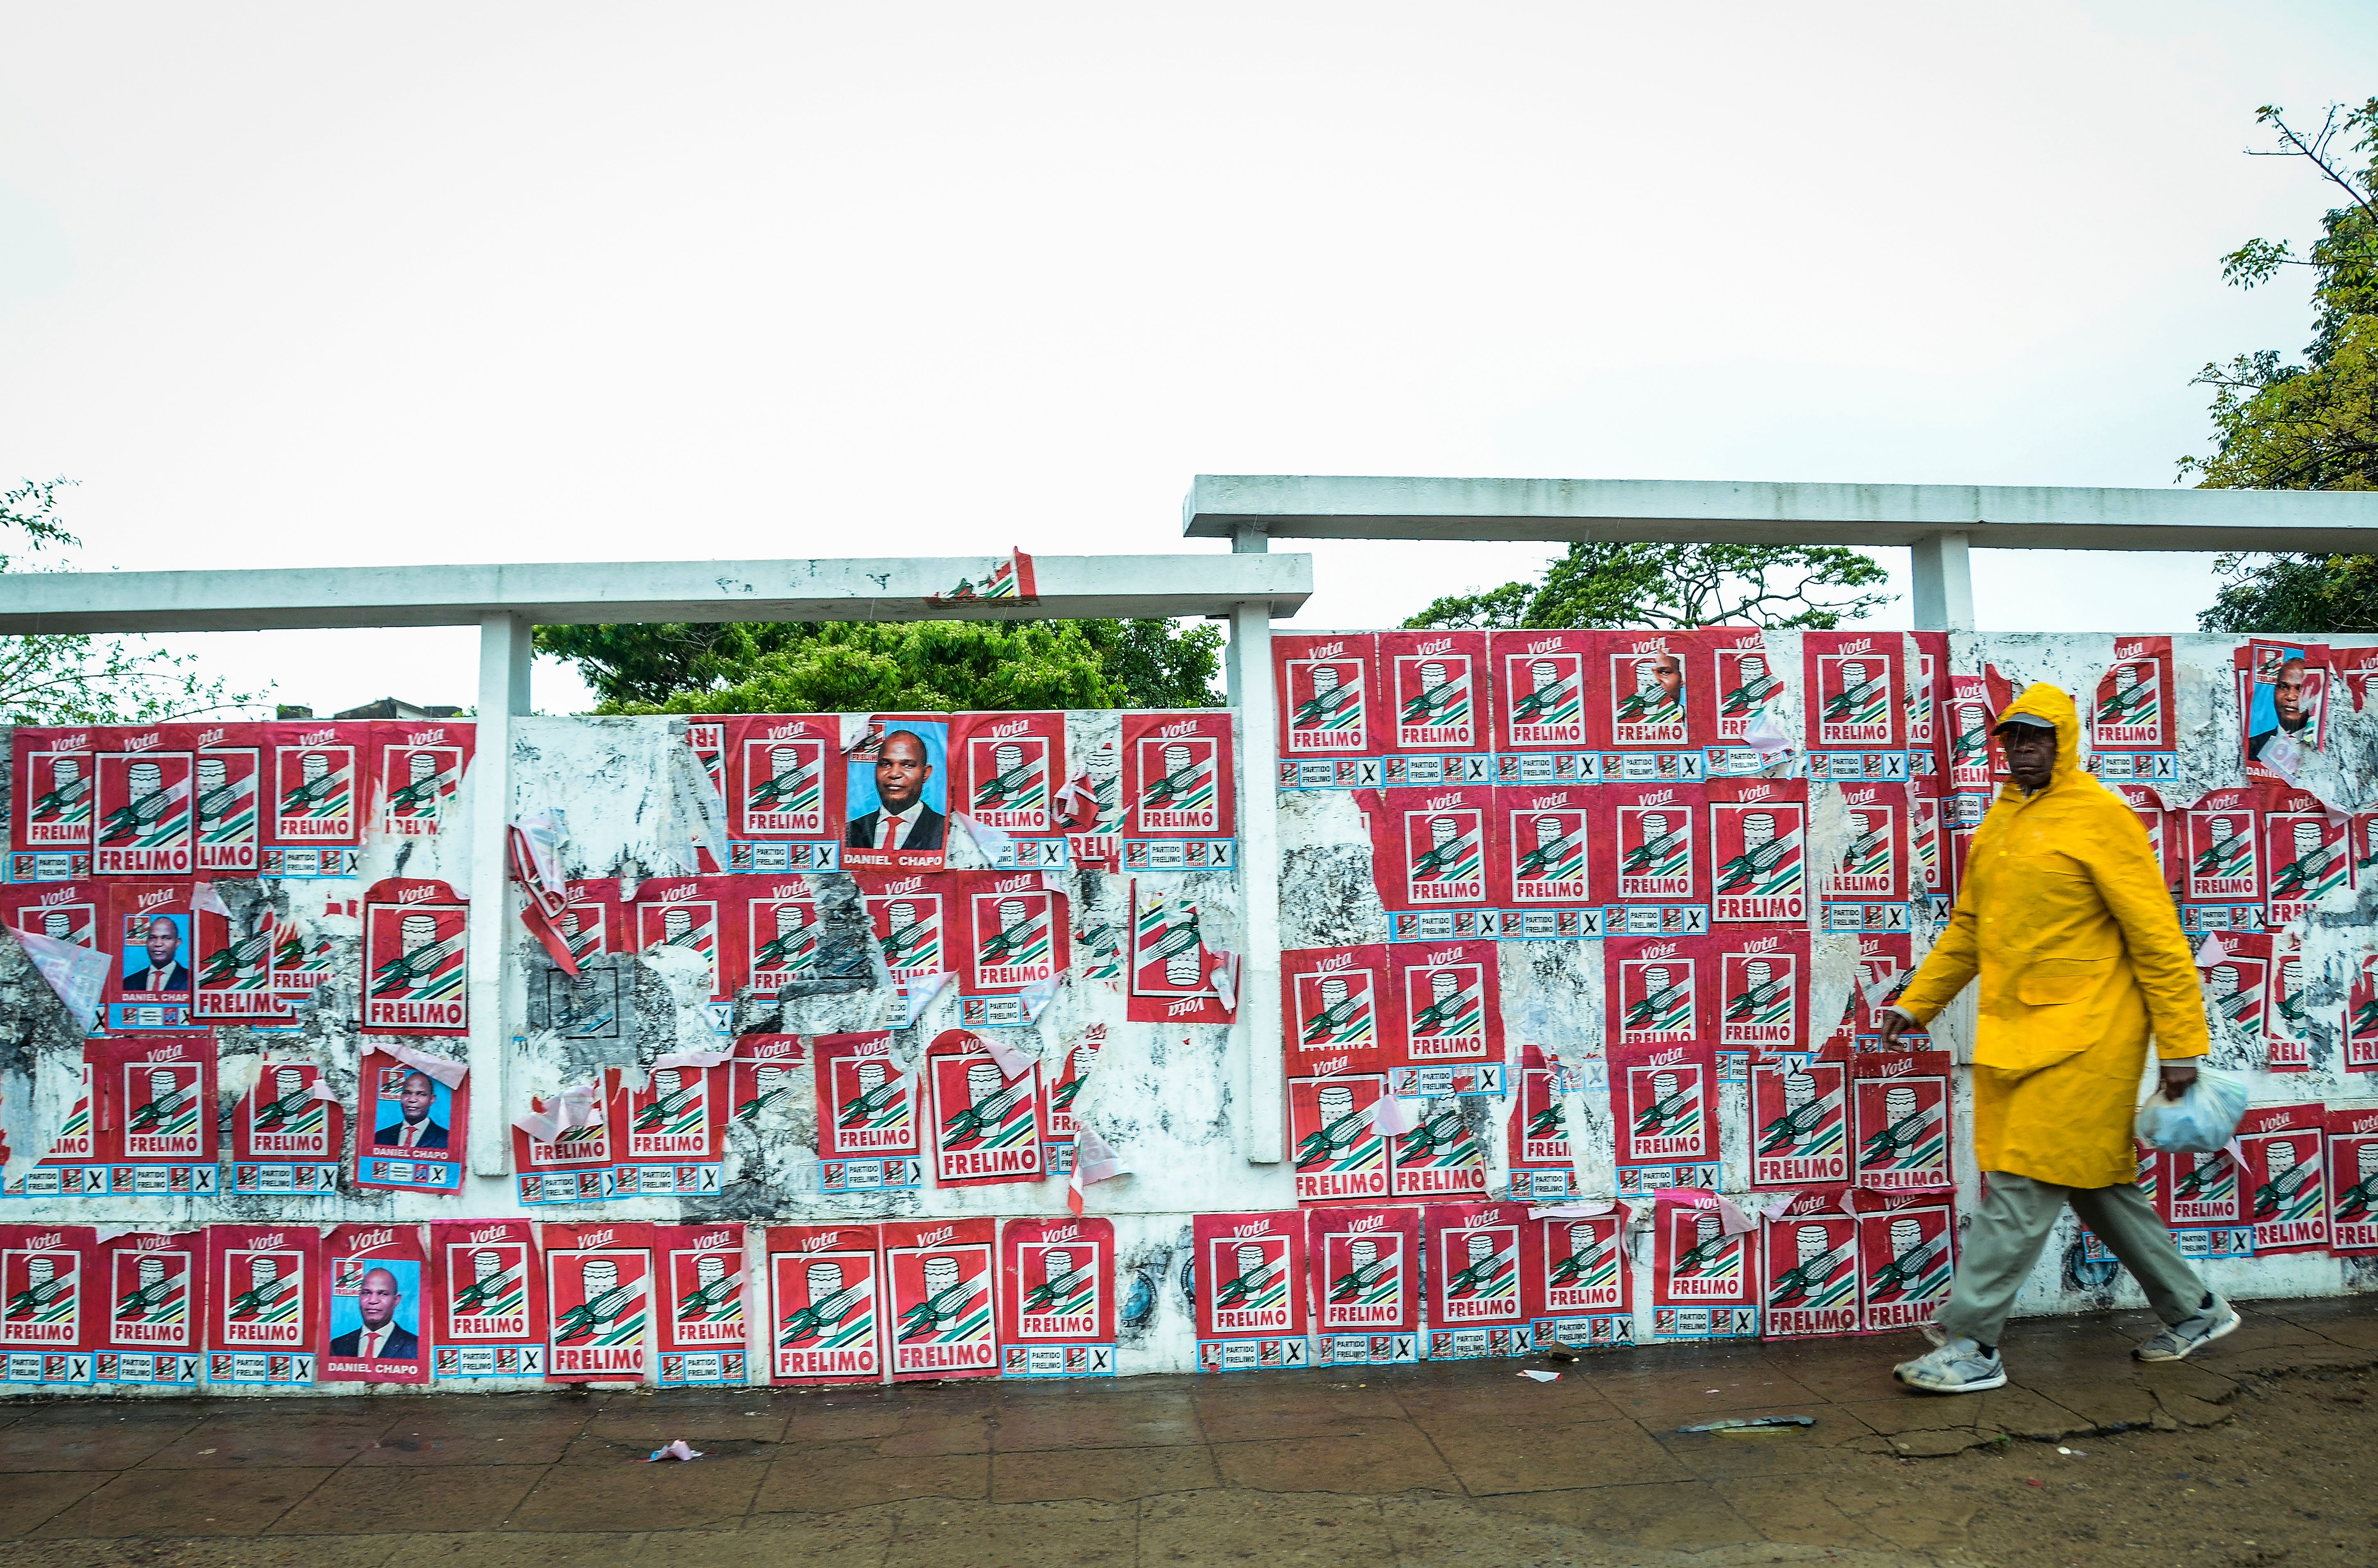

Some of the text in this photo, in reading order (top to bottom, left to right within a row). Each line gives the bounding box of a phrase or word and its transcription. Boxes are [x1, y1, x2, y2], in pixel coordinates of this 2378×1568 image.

[1308, 639, 1344, 659] Vota
[1416, 637, 1452, 655] Vota
[1527, 636, 1563, 654] Vota
[1633, 636, 1665, 654] Vota
[1838, 636, 1871, 654] Vota
[299, 728, 336, 747] Vota
[408, 728, 445, 746] Vota
[768, 721, 803, 739] Vota
[991, 720, 1028, 737] Vota
[1161, 719, 1197, 738] Vota
[1403, 728, 1468, 742] FRELIMO
[1515, 726, 1580, 740] FRELIMO
[1619, 726, 1682, 739] FRELIMO
[1826, 726, 1887, 739] FRELIMO
[2099, 728, 2156, 740] FRELIMO
[52, 732, 87, 751] Vota
[124, 732, 160, 751] Vota
[1294, 732, 1361, 746] FRELIMO
[1427, 793, 1462, 811] Vota
[1532, 792, 1567, 810] Vota
[1638, 788, 1672, 807] Vota
[1737, 784, 1770, 802] Vota
[1845, 787, 1875, 804] Vota
[2207, 794, 2239, 810] Vota
[282, 820, 348, 834] FRELIMO
[749, 815, 818, 828] FRELIMO
[975, 812, 1044, 826] FRELIMO
[1145, 812, 1213, 826] FRELIMO
[33, 825, 92, 839] FRELIM
[100, 851, 188, 869] FRELIMO
[843, 855, 942, 866] DANIEL CHAPO
[660, 883, 697, 901] Vota
[884, 877, 921, 894] Vota
[995, 874, 1032, 892] Vota
[1414, 883, 1480, 898] FRELIMO
[1519, 883, 1583, 897] FRELIMO
[1624, 879, 1688, 892] FRELIMO
[2196, 880, 2253, 892] FRELIMO
[40, 886, 75, 905] Vota
[138, 888, 175, 908] Vota
[397, 885, 434, 904] Vota
[1719, 899, 1801, 917] FRELIMO
[1642, 942, 1677, 960] Vota
[1744, 936, 1778, 953] Vota
[1315, 951, 1352, 972] Vota
[1427, 947, 1463, 965] Vota
[981, 966, 1049, 983] FRELIMO
[372, 1003, 462, 1023] FRELIMO
[1168, 1000, 1205, 1017] Vota
[1727, 1026, 1790, 1039] FRELIMO
[147, 1042, 183, 1062] Vota
[753, 1041, 791, 1058] Vota
[853, 1037, 890, 1055] Vota
[1414, 1038, 1481, 1054] FRELIMO
[1649, 1046, 1684, 1066] Vota
[1312, 1056, 1349, 1075] Vota
[1881, 1058, 1913, 1076] Vota
[2260, 1112, 2290, 1132] Vota
[131, 1138, 197, 1151] FRELIMO
[256, 1136, 322, 1150] FRELIMO
[635, 1137, 703, 1151] FRELIMO
[840, 1130, 910, 1146] FRELIMO
[1636, 1138, 1699, 1153] FRELIMO
[373, 1148, 448, 1159] DANIEL CHAPO
[536, 1143, 604, 1159] FRELIMO
[944, 1150, 1036, 1174] FRELIMO
[1760, 1159, 1843, 1179] FRELIMO
[1297, 1173, 1384, 1195] FRELIMO
[1398, 1170, 1485, 1191] FRELIMO
[1792, 1195, 1825, 1214] Vota
[2176, 1204, 2234, 1216] FRELIMO
[1348, 1214, 1384, 1232] Vota
[1463, 1209, 1500, 1227] Vota
[469, 1225, 506, 1244] Vota
[916, 1226, 953, 1246] Vota
[1042, 1224, 1079, 1243] Vota
[1233, 1219, 1270, 1237] Vota
[25, 1232, 61, 1251] Vota
[136, 1232, 172, 1252] Vota
[248, 1232, 283, 1251] Vota
[348, 1228, 392, 1251] Vota
[577, 1229, 613, 1249] Vota
[693, 1231, 730, 1249] Vota
[801, 1231, 837, 1250] Vota
[1674, 1280, 1738, 1294] FRELIMO
[1551, 1288, 1616, 1305] FRELIMO
[1330, 1307, 1397, 1321] FRELIMO
[1449, 1300, 1515, 1316] FRELIMO
[455, 1318, 523, 1333] FRELIMO
[1025, 1317, 1093, 1332] FRELIMO
[1218, 1310, 1286, 1326] FRELIMO
[1772, 1310, 1854, 1330] FRELIMO
[7, 1325, 73, 1340] FRELIMO
[117, 1325, 183, 1340] FRELIMO
[230, 1325, 297, 1340] FRELIMO
[557, 1349, 643, 1369] FRELIMO
[781, 1351, 873, 1372] FRELIMO
[900, 1344, 991, 1368] FRELIMO
[328, 1362, 418, 1374] DANIEL CHAPO
